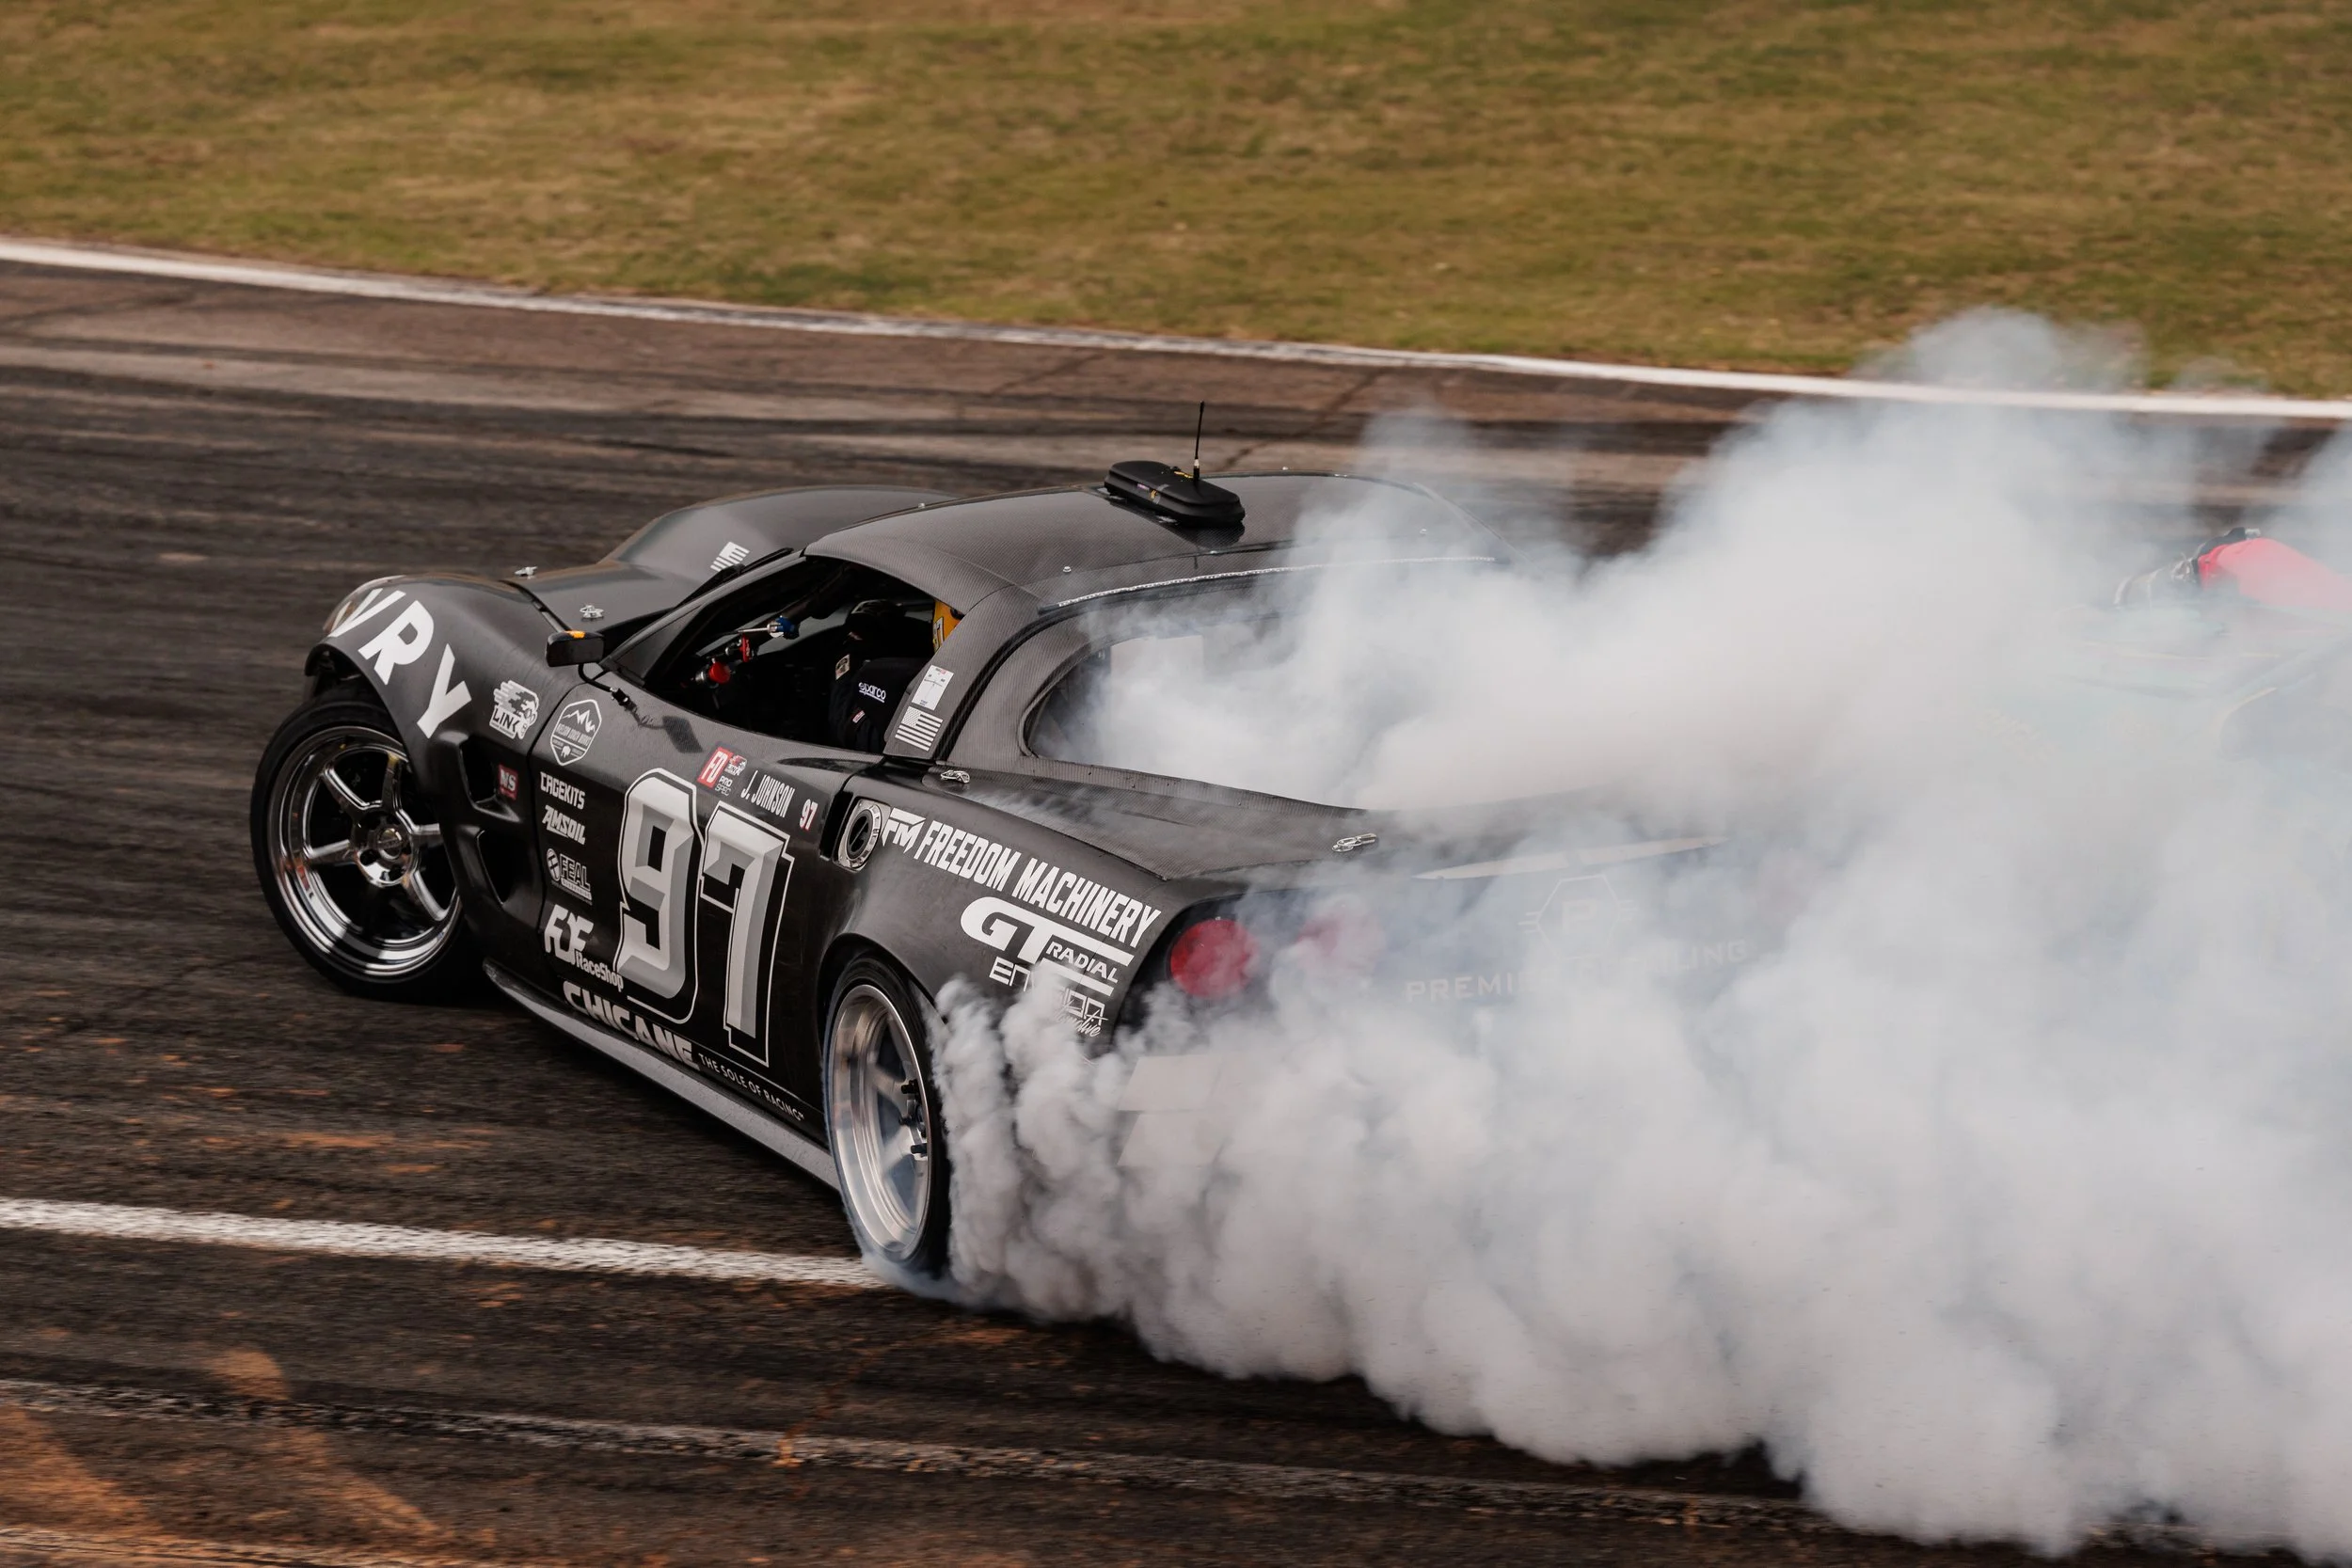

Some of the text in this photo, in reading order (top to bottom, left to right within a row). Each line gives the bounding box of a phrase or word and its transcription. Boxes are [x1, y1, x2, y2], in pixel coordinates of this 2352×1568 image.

[858, 682, 886, 701] sparco
[492, 707, 520, 733] LINK
[540, 771, 585, 810] CAGEKITS
[715, 784, 732, 797] SPEC
[718, 775, 733, 787] PRO
[740, 769, 795, 818] J. JOHNSON
[542, 804, 585, 846] AMSOIL
[799, 799, 818, 832] 97
[559, 853, 591, 892] FEAL
[914, 819, 1162, 948] FREEDOM MACHINERY
[612, 768, 796, 1068] 97
[961, 896, 1135, 967] GT
[575, 951, 624, 992] RaceShop
[1045, 942, 1119, 983] RADIAL
[564, 980, 701, 1071] CHICANE
[698, 1053, 721, 1073] THE
[720, 1065, 748, 1089] SOLE
[748, 1080, 762, 1096] OF
